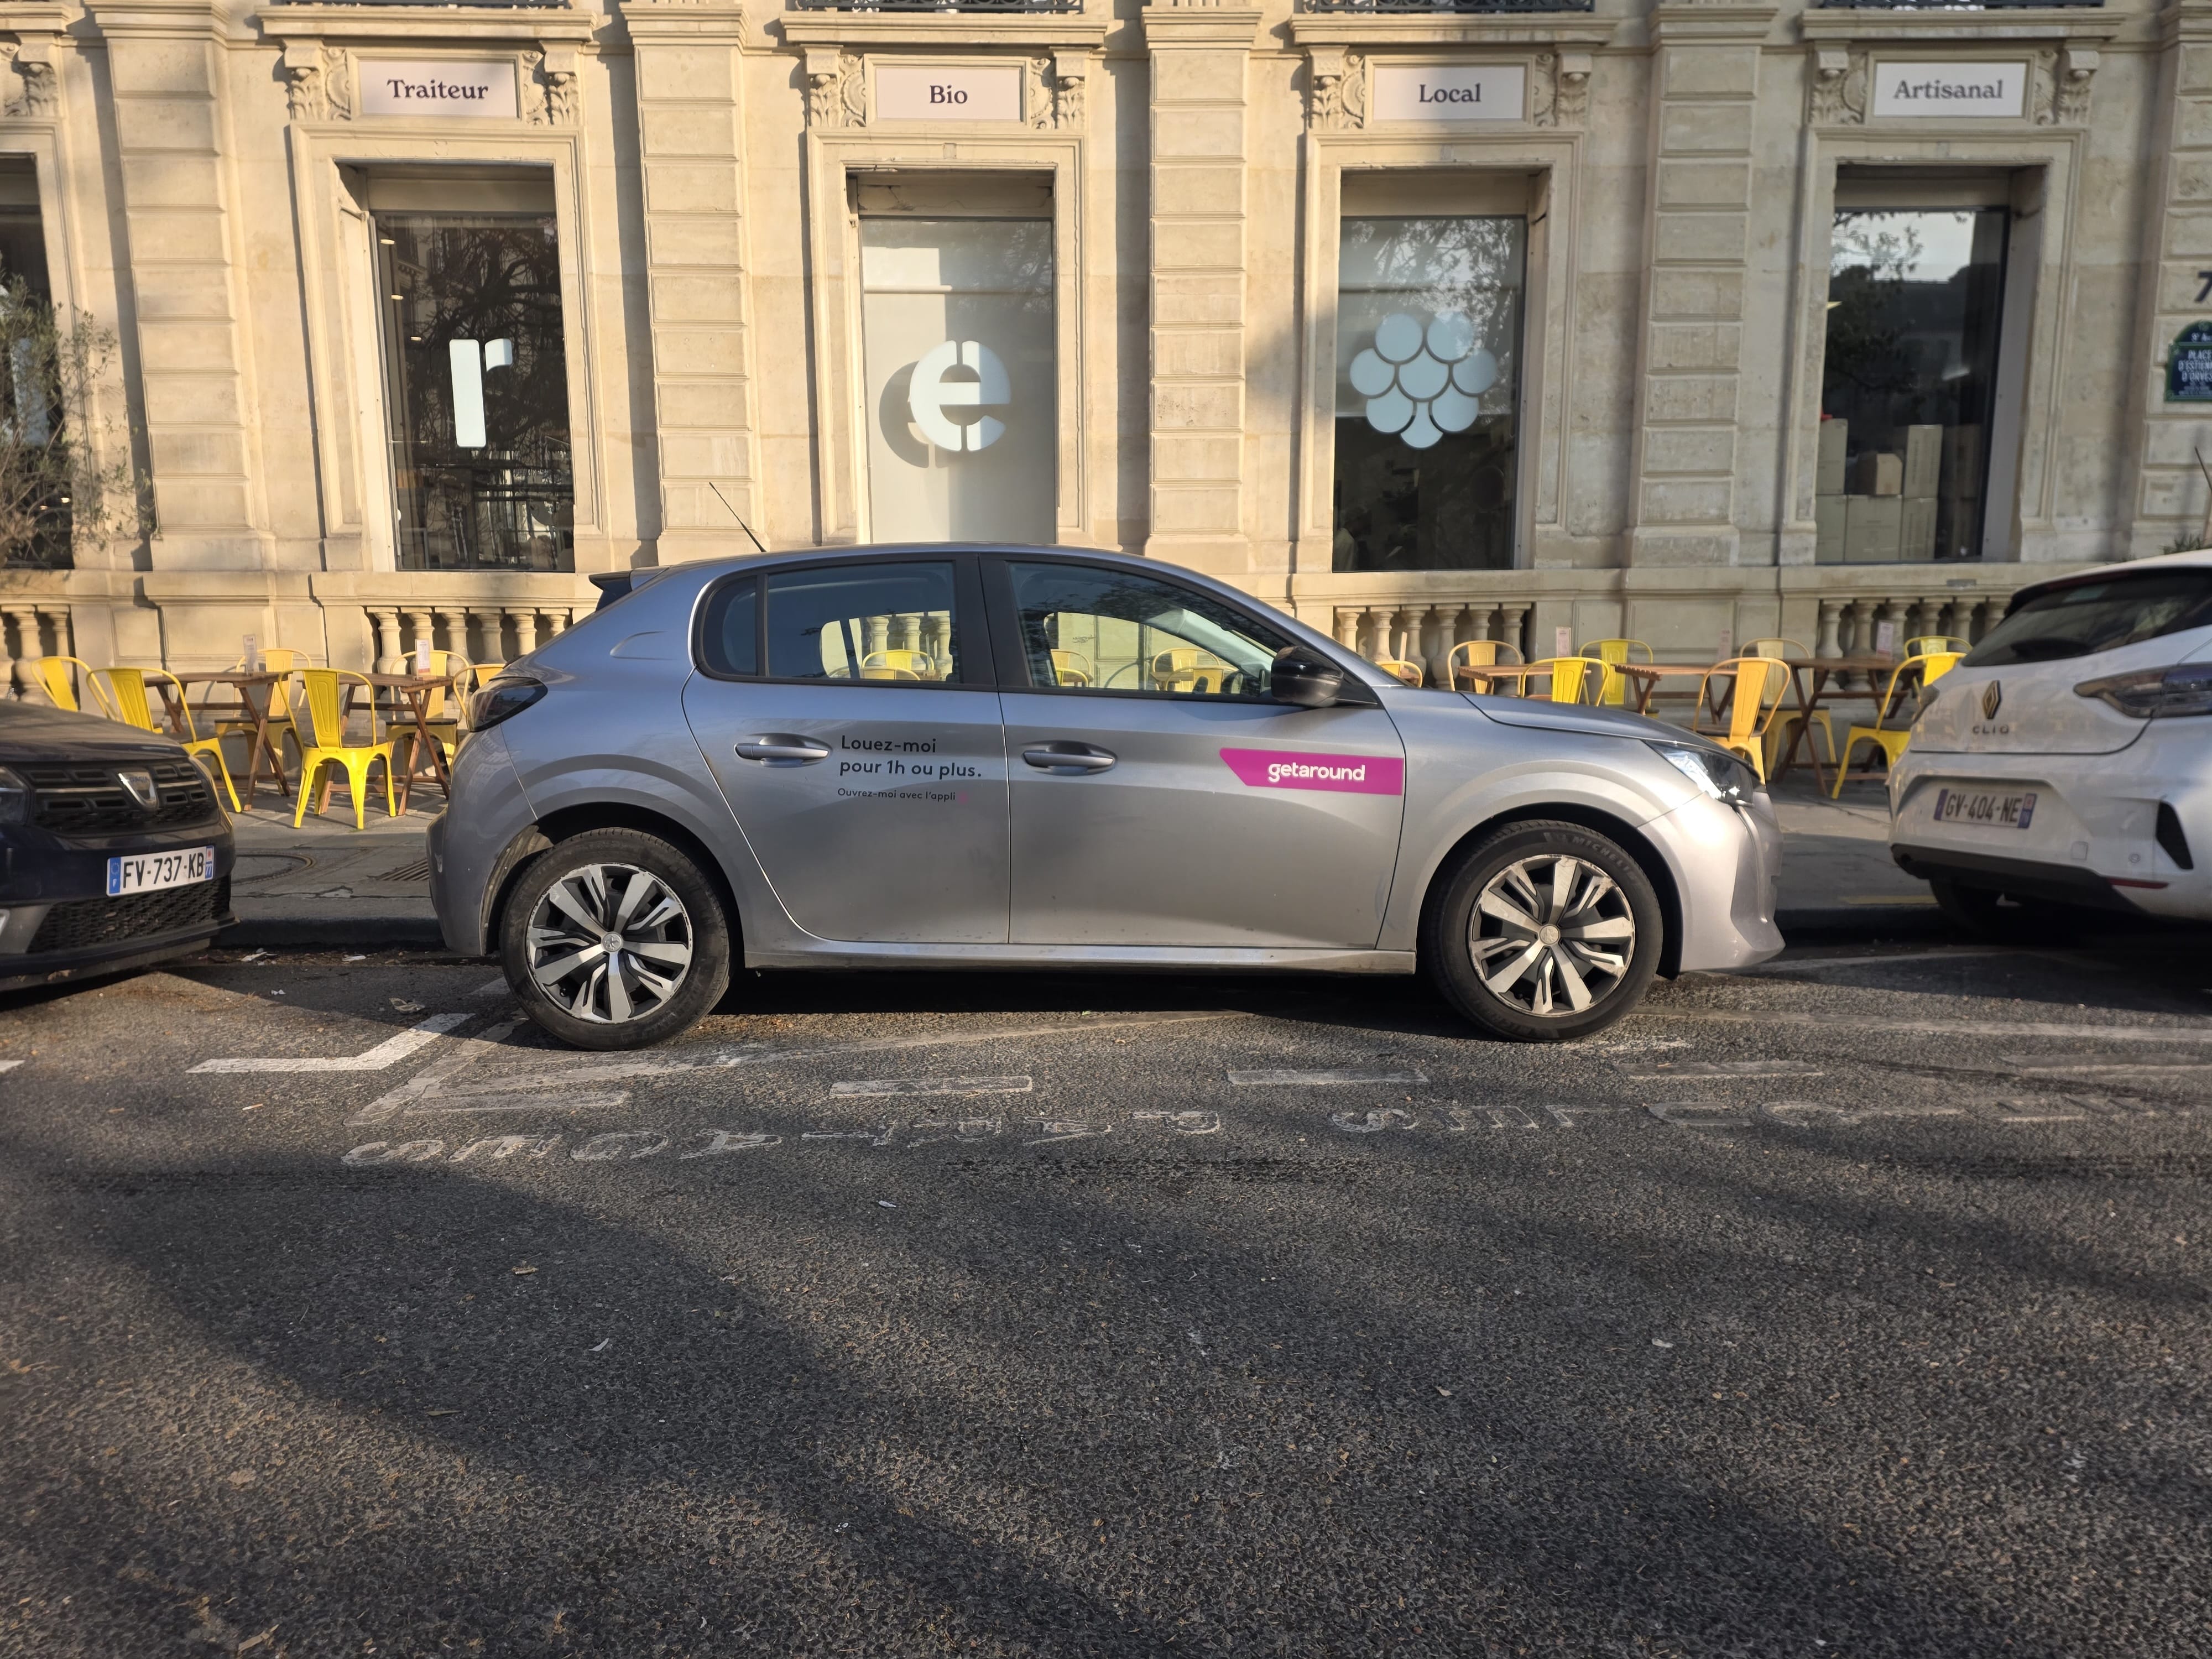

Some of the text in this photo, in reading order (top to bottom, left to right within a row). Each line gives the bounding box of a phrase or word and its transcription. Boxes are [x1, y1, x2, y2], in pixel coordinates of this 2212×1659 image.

[387, 79, 489, 99] Traiteur
[929, 85, 968, 104] Bio
[1418, 83, 1481, 103] Local
[1893, 79, 2004, 100] Artisanal
[2188, 349, 2211, 360] PLACE
[1972, 724, 2010, 735] CLIO
[841, 735, 936, 753] Louez-moi
[839, 760, 982, 780] pour 1h ou plus.
[1268, 762, 1366, 782] getaround
[837, 787, 897, 799] Ouvrez-moi
[925, 791, 956, 802] l'appli
[123, 852, 205, 889] FV-737-KB
[205, 863, 212, 876] 77
